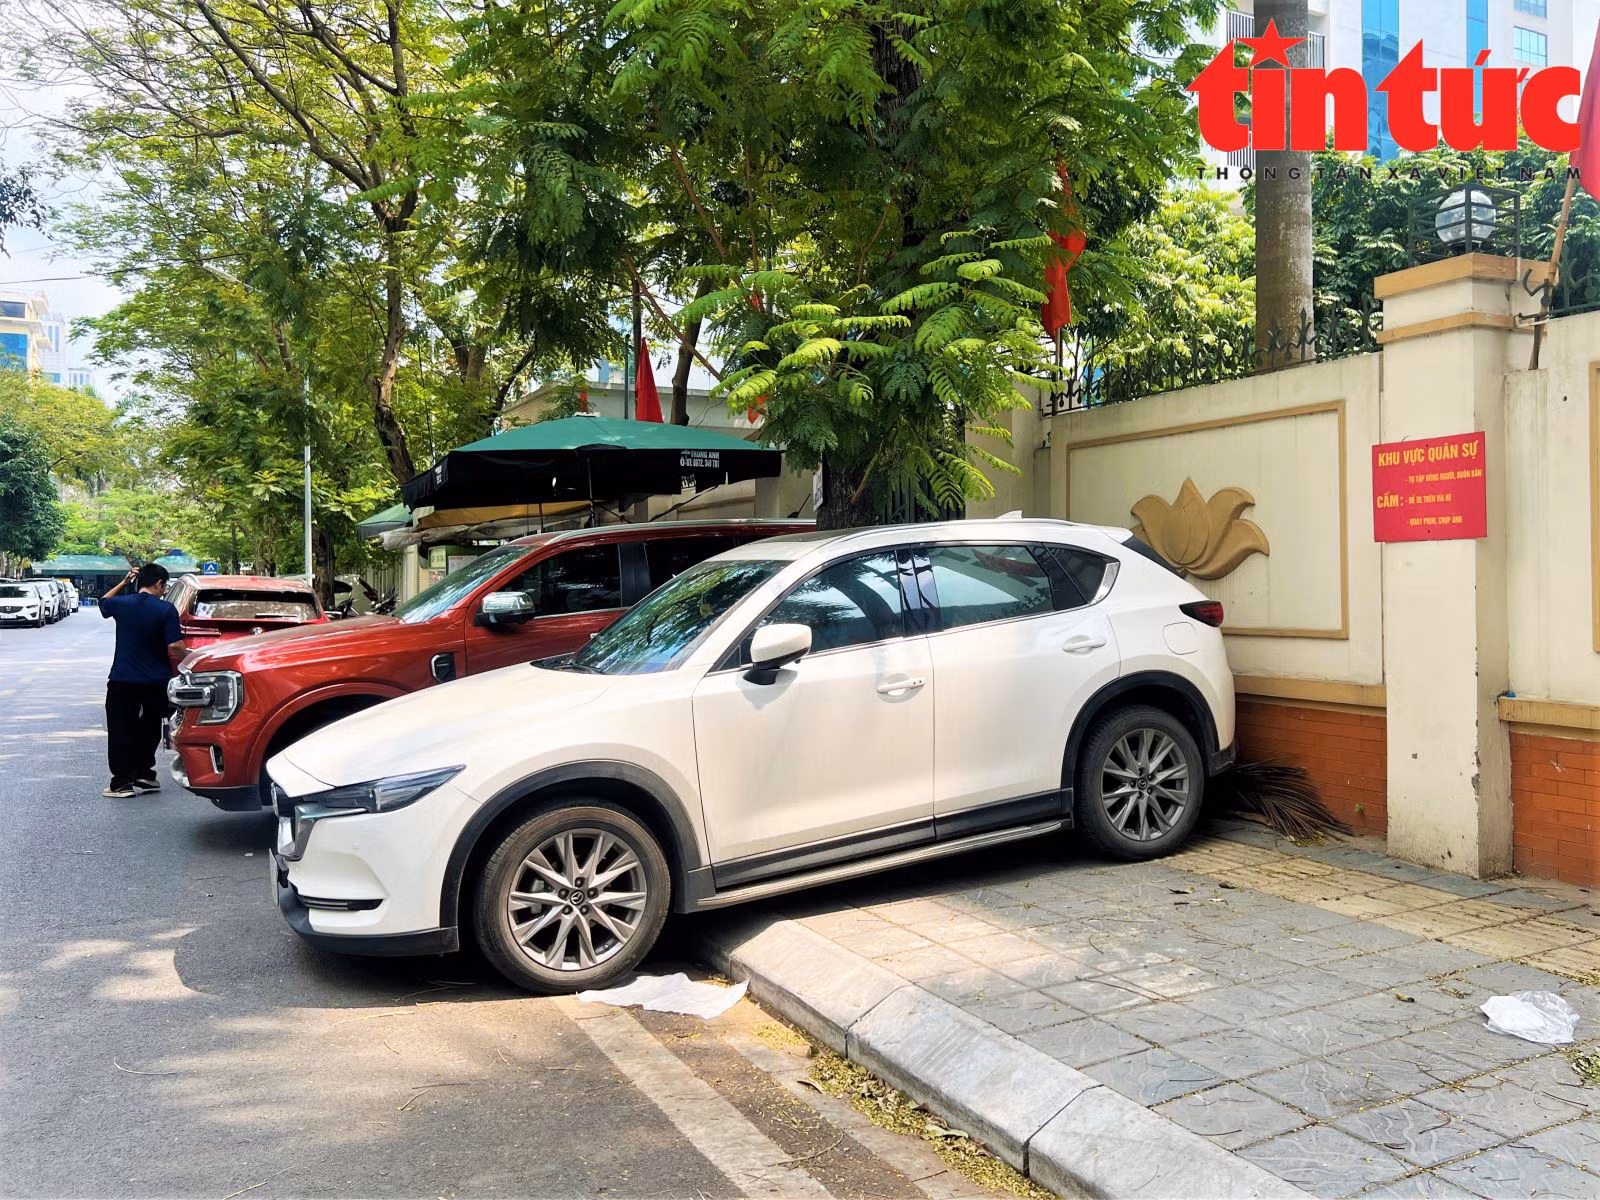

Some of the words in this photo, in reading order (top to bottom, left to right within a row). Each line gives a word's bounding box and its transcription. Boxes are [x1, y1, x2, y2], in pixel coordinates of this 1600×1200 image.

[1378, 452, 1400, 467] KHU
[1403, 448, 1424, 466] VỰC
[1428, 443, 1459, 463] QUÂN
[1462, 440, 1479, 460] SỰ
[1376, 491, 1399, 508] CẤM
